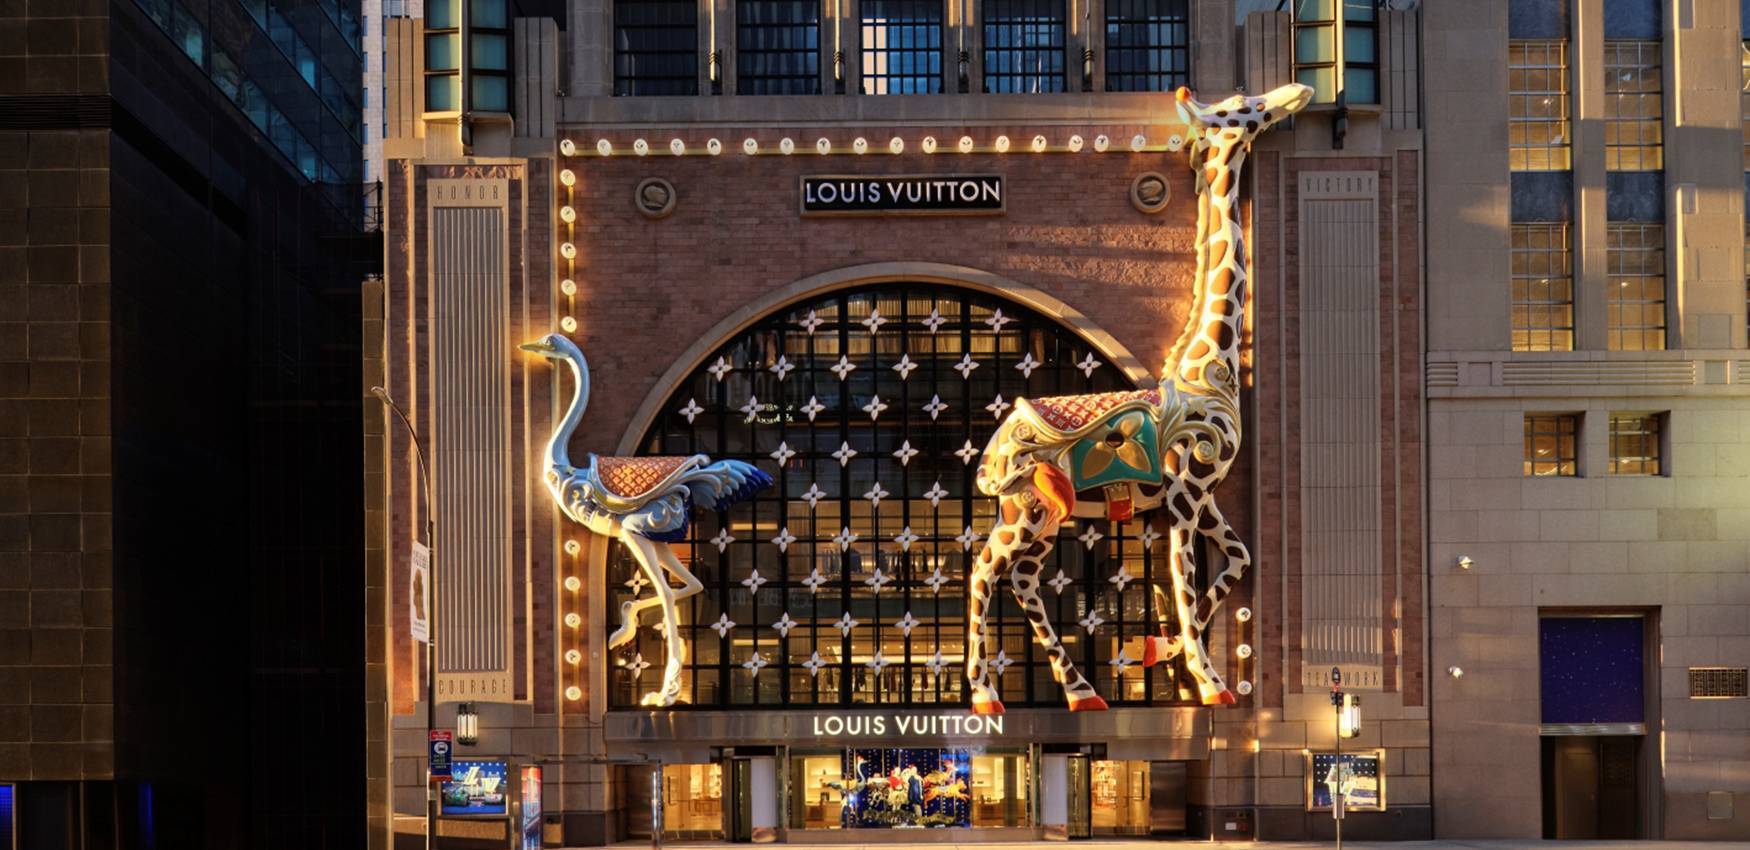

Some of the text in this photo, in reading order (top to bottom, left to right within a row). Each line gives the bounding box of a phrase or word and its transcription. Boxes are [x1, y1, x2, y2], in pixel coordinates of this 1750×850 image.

[437, 185, 499, 200] HONOR
[806, 180, 1001, 203] LOUIS VUITTON
[1306, 177, 1373, 193] VICTORY
[1306, 671, 1379, 686] TEAWORK
[438, 679, 507, 695] COURAGE
[813, 715, 1004, 736] LOUIS VUITTON
